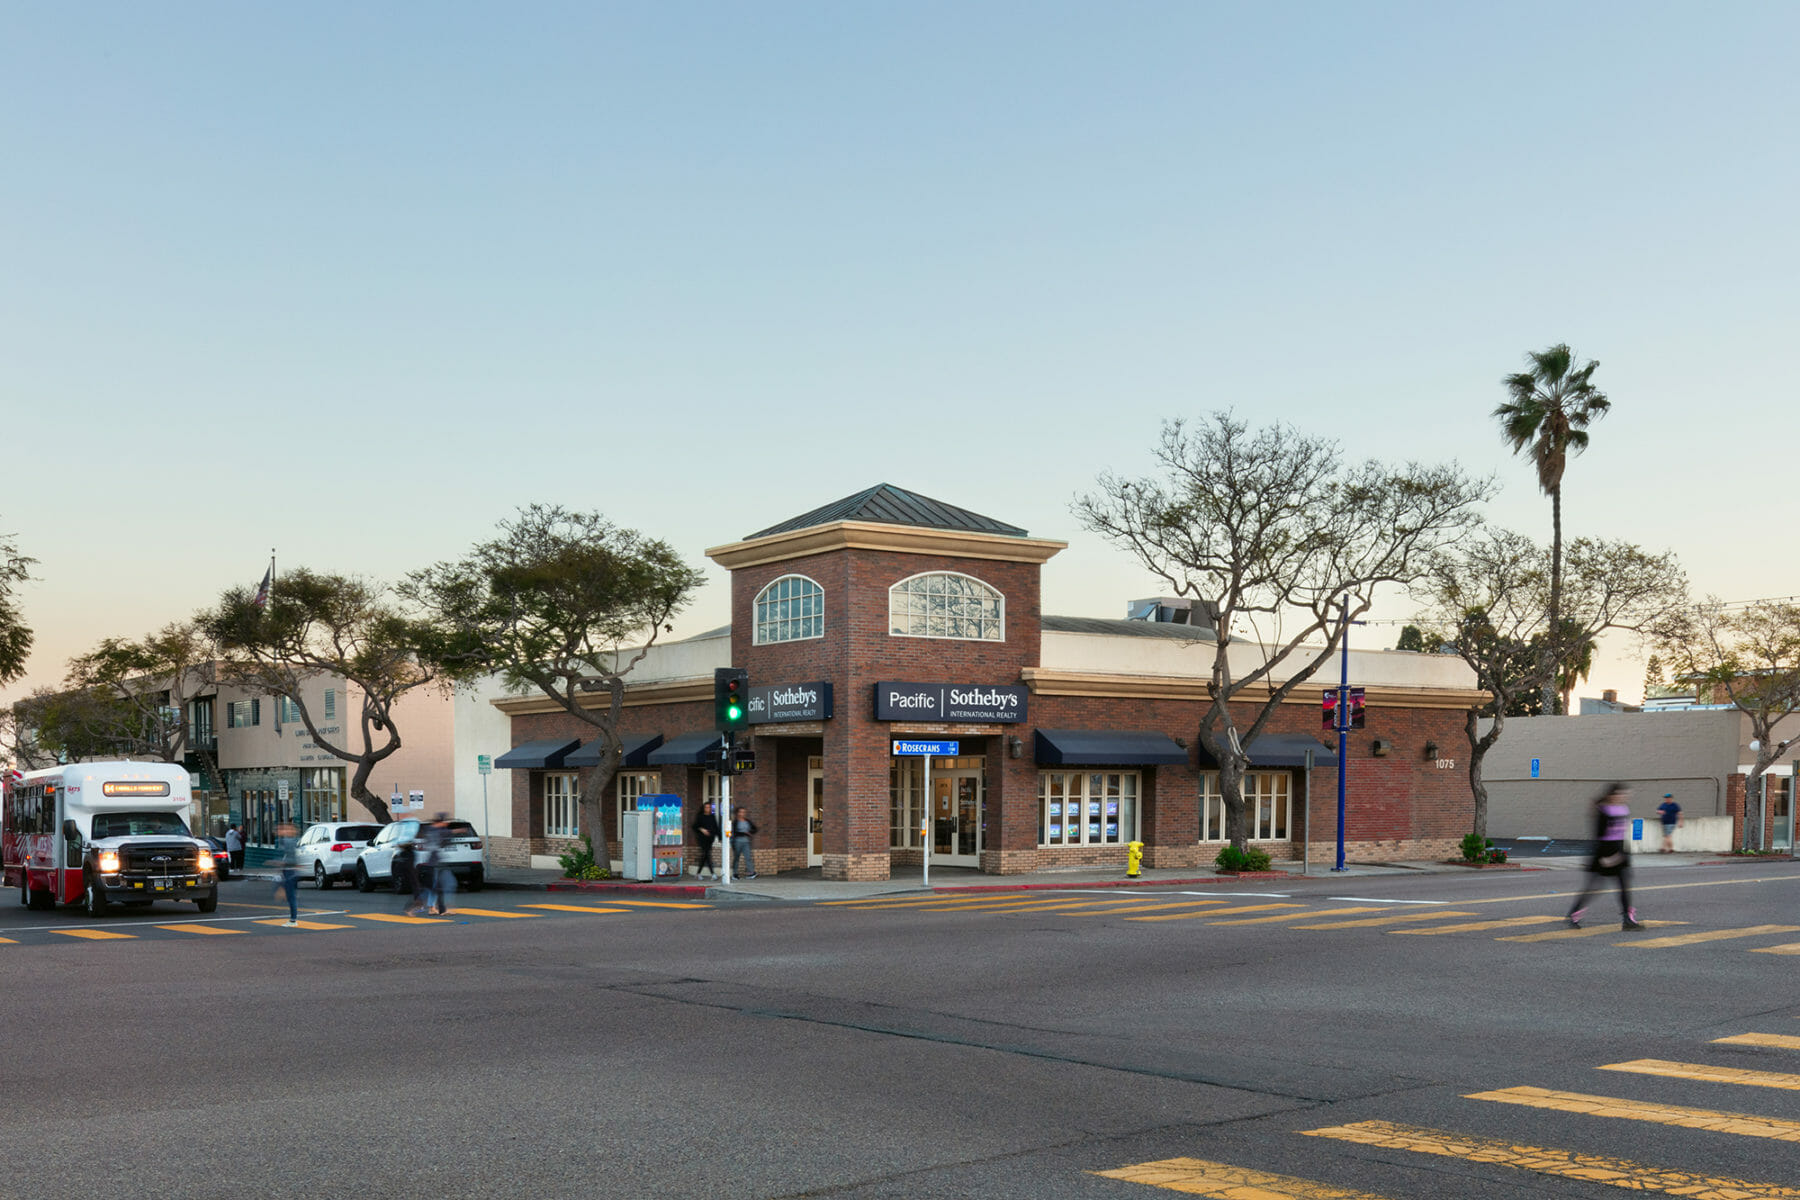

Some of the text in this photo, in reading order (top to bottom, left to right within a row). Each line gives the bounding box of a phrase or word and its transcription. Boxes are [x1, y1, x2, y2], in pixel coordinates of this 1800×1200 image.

[748, 697, 765, 712] cific
[773, 687, 817, 708] Sotheby's
[890, 692, 934, 708] Pacific
[950, 688, 1017, 710] Sotheby's
[774, 710, 802, 718] INTERNATIONAL
[902, 743, 939, 752] ROSECRANS
[1435, 759, 1454, 769] 1075
